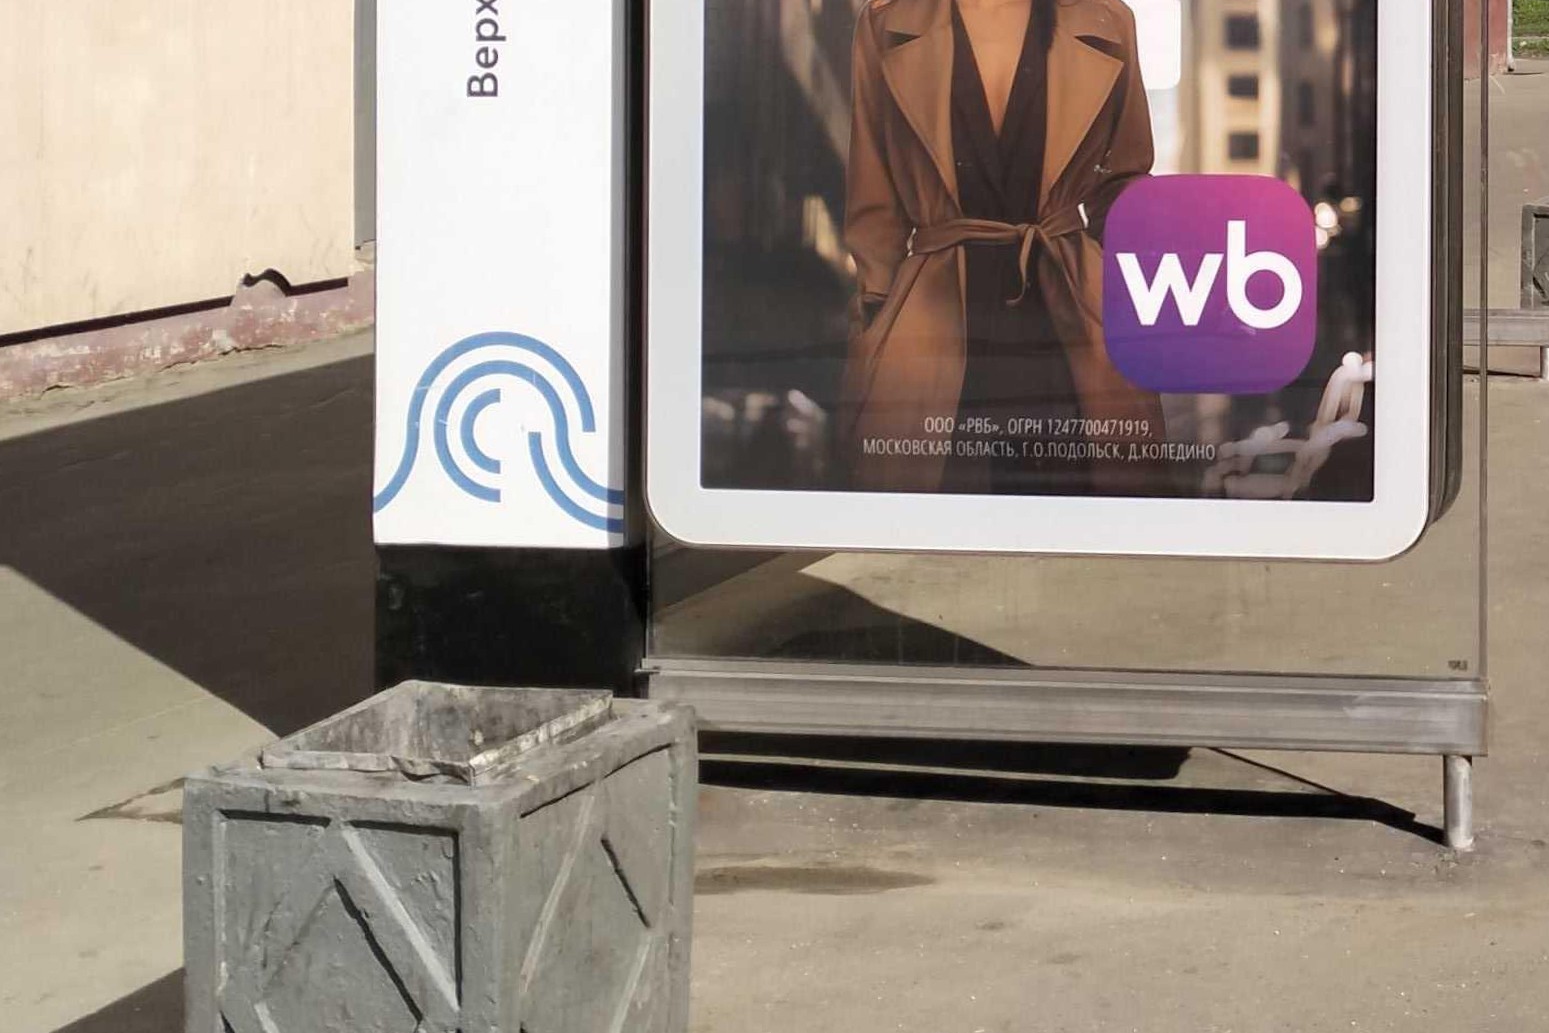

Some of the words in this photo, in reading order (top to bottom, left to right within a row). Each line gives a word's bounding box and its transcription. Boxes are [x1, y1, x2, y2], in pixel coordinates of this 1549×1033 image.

[1116, 220, 1303, 329] wb
[924, 416, 954, 433] ООО
[1007, 418, 1042, 435] ОГРН
[863, 438, 951, 456] МОСКОВСКАЯ
[956, 440, 1019, 458] ОБЛАСТЬ,
